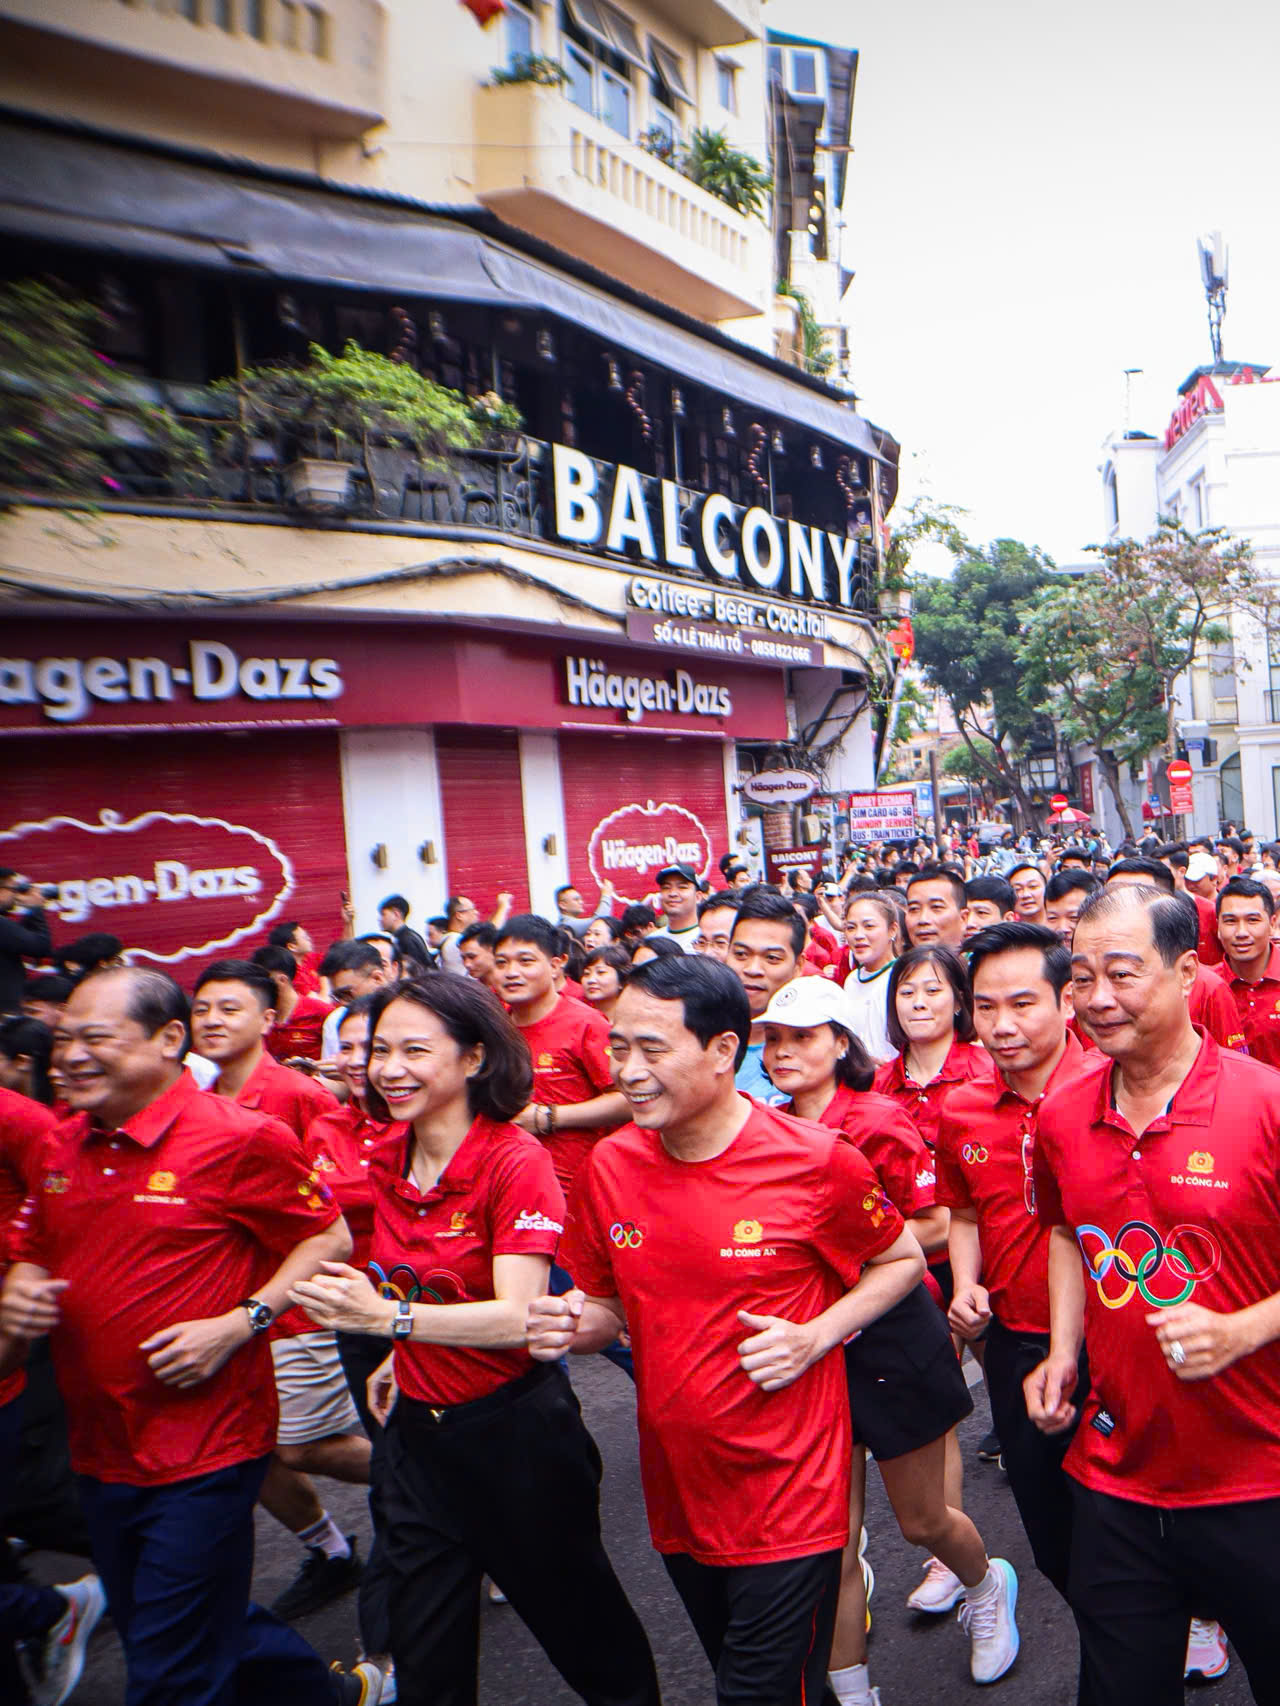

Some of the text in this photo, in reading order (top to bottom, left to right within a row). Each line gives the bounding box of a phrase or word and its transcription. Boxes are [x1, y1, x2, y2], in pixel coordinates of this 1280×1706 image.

[552, 443, 858, 606] BALCONY
[631, 576, 700, 617] Coffee
[715, 593, 756, 625] Beer
[766, 603, 829, 640] Cocktail
[672, 628, 682, 643] 4
[682, 625, 699, 646] LÊ
[699, 630, 726, 650] THÁI
[566, 656, 733, 722] Häagen-Dazs
[751, 780, 807, 793] Häagen-Dazs
[852, 808, 866, 818] SIM
[868, 808, 887, 817] CARD
[902, 807, 912, 816] 5G
[852, 818, 912, 829] LAUNDRY SERVICE
[852, 831, 866, 840] BUS
[870, 829, 890, 839] TRAIN
[891, 828, 912, 838] TICKET
[602, 837, 701, 874] Häagen-Dazs
[1185, 1175, 1213, 1188] CÔNG
[1214, 1179, 1229, 1189] AN
[735, 1247, 761, 1258] CÔNG
[763, 1247, 777, 1257] AN
